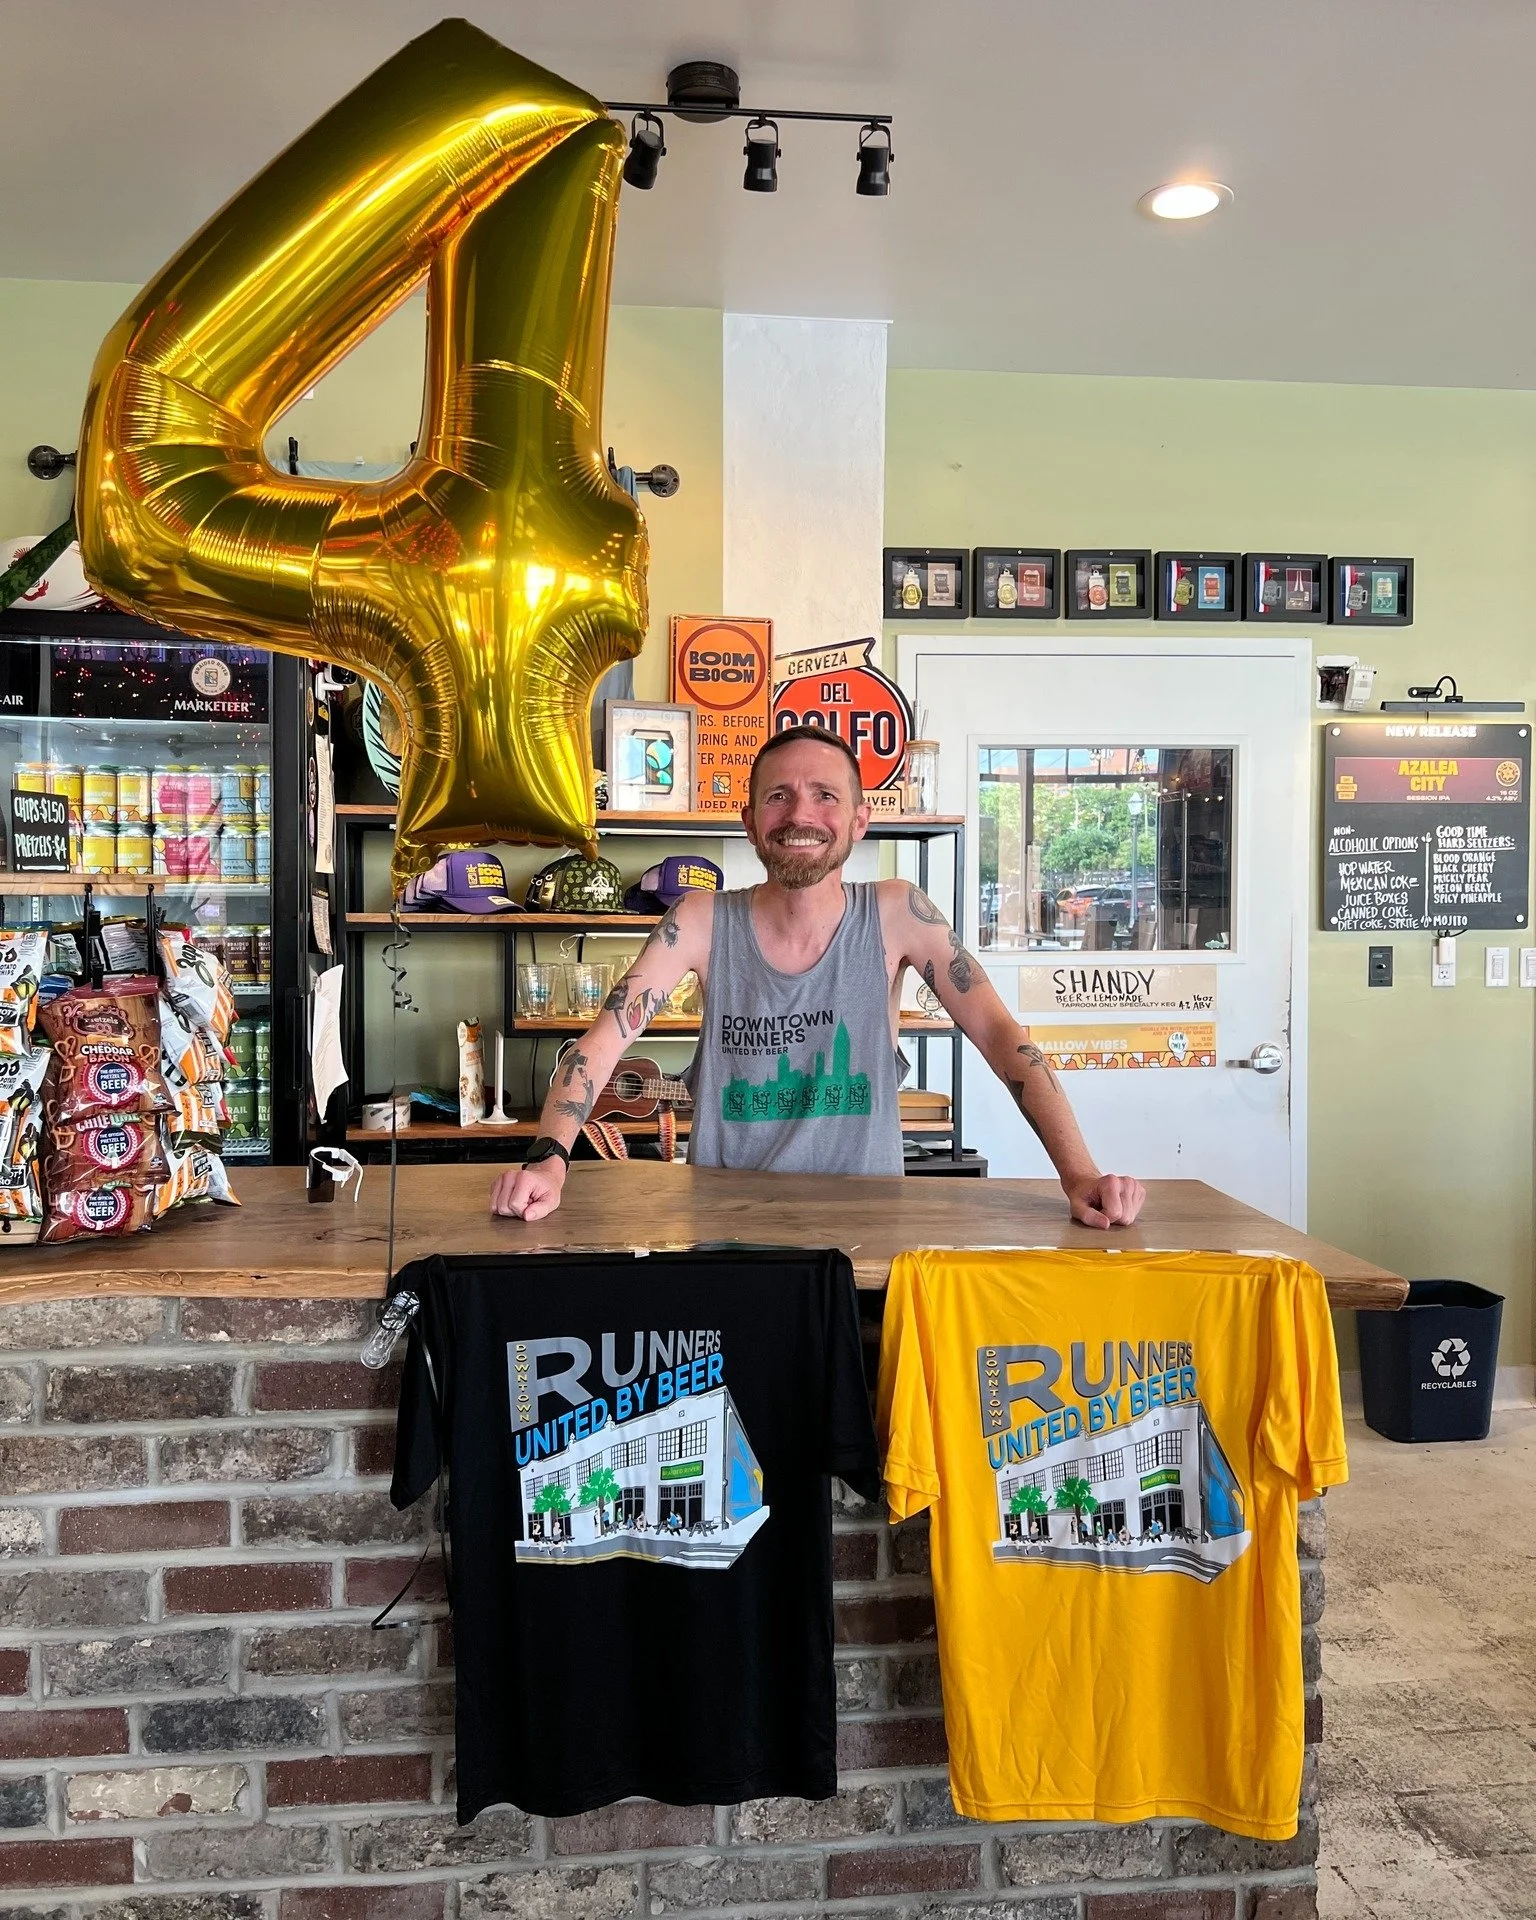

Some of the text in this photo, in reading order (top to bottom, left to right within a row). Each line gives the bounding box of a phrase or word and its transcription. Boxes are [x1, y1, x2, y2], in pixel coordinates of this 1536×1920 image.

[690, 651, 755, 667] BOOM
[788, 651, 848, 676] CERVEZA
[690, 668, 755, 683] BOOM
[821, 683, 852, 703] DEL
[723, 715, 765, 728] BEFORE
[1385, 725, 1476, 738] NEW RELEASE
[735, 735, 758, 747] AND
[721, 753, 757, 766] PARAD
[1398, 760, 1459, 776] AZALEA
[1410, 776, 1446, 792] CITY
[698, 800, 727, 809] IDED
[866, 796, 896, 806] IVER
[1333, 825, 1355, 836] NON-
[1436, 825, 1488, 838] GOOD TIME
[1328, 836, 1419, 853] ALCOHOLIC OPTIONS
[1437, 838, 1465, 849] HARD
[1433, 852, 1496, 864] BLOOD ORANGE
[1338, 860, 1395, 876] HOP WATER
[1433, 862, 1494, 874] BLACK CHERRY
[1340, 874, 1420, 893] MEXICAN COKE
[1433, 873, 1489, 884] PRICKLY PEAR
[1433, 882, 1492, 894] MELON BERRY
[1341, 891, 1409, 909] JUICE BOXES
[1433, 892, 1503, 904] SPICY PINEAPPLE
[1337, 907, 1378, 920] CANNED
[1337, 919, 1359, 931] DIET
[1388, 917, 1419, 929] SPRITE
[1433, 915, 1468, 927] MOJITO
[1053, 969, 1155, 995] SHANDY
[1055, 993, 1083, 1004] BEER
[1093, 992, 1143, 1003] LEMONADE
[1192, 1001, 1211, 1011] ABV
[722, 1010, 834, 1031] DOWNTOWN
[722, 1028, 806, 1047] RUNNERS
[1091, 1038, 1128, 1050] VIBES
[81, 1045, 134, 1056] CHEDDAR
[722, 1047, 749, 1056] UNITED
[766, 1047, 788, 1055] BEER
[89, 1055, 130, 1063] BACON
[101, 1079, 128, 1090] BEER
[101, 1143, 128, 1154] BEER
[88, 1207, 114, 1217] BEER
[507, 1330, 721, 1432] RUNNERS
[515, 1344, 531, 1422] DOWNTOWN
[985, 1349, 1003, 1426] DOWNTOWN
[1421, 1380, 1477, 1390] RECYCLABLES
[977, 1341, 1193, 1438] RUNNERS
[515, 1353, 724, 1466] UNITED BY BEER
[988, 1365, 1197, 1470] UNITED BY BEER
